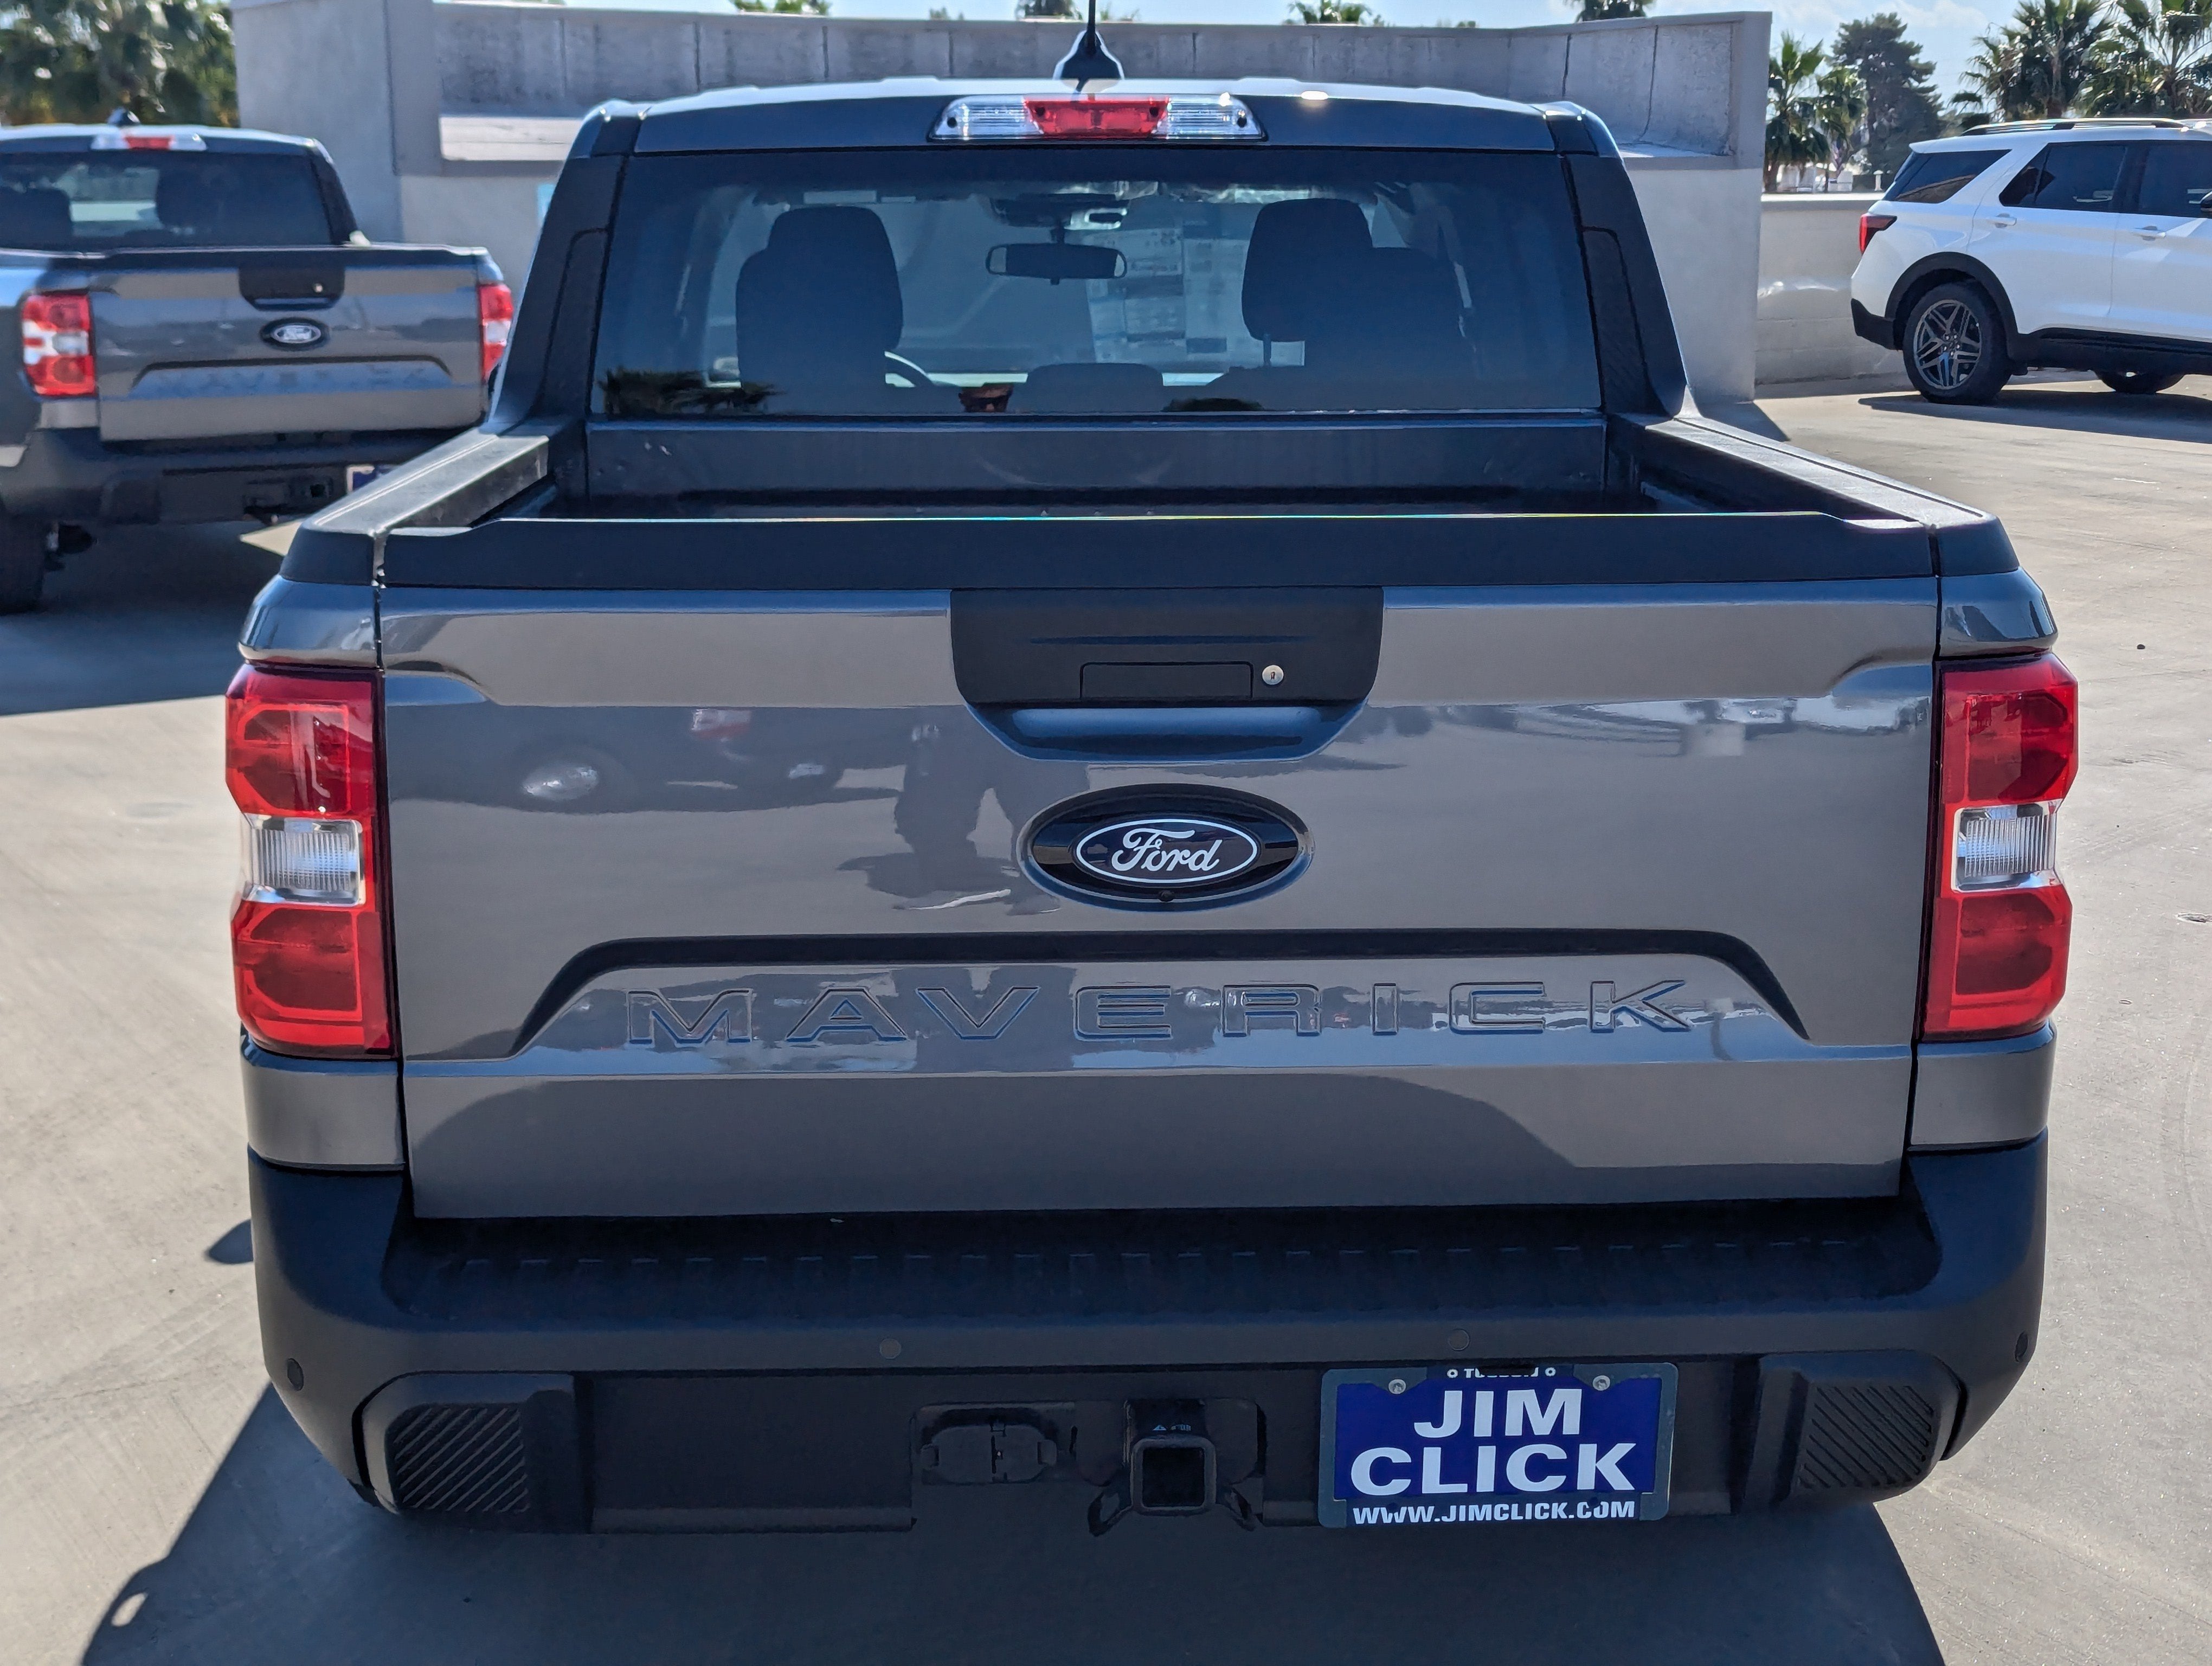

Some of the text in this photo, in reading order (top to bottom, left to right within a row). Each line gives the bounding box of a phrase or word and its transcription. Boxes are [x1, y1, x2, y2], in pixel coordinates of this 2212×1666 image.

[1111, 827, 1223, 872] Ford
[627, 979, 1692, 1046] MAVERICK
[1413, 1388, 1583, 1438] JIM
[1351, 1443, 1637, 1496] CLICK
[1353, 1501, 1636, 1524] WWW.JIMCLICK.COM
